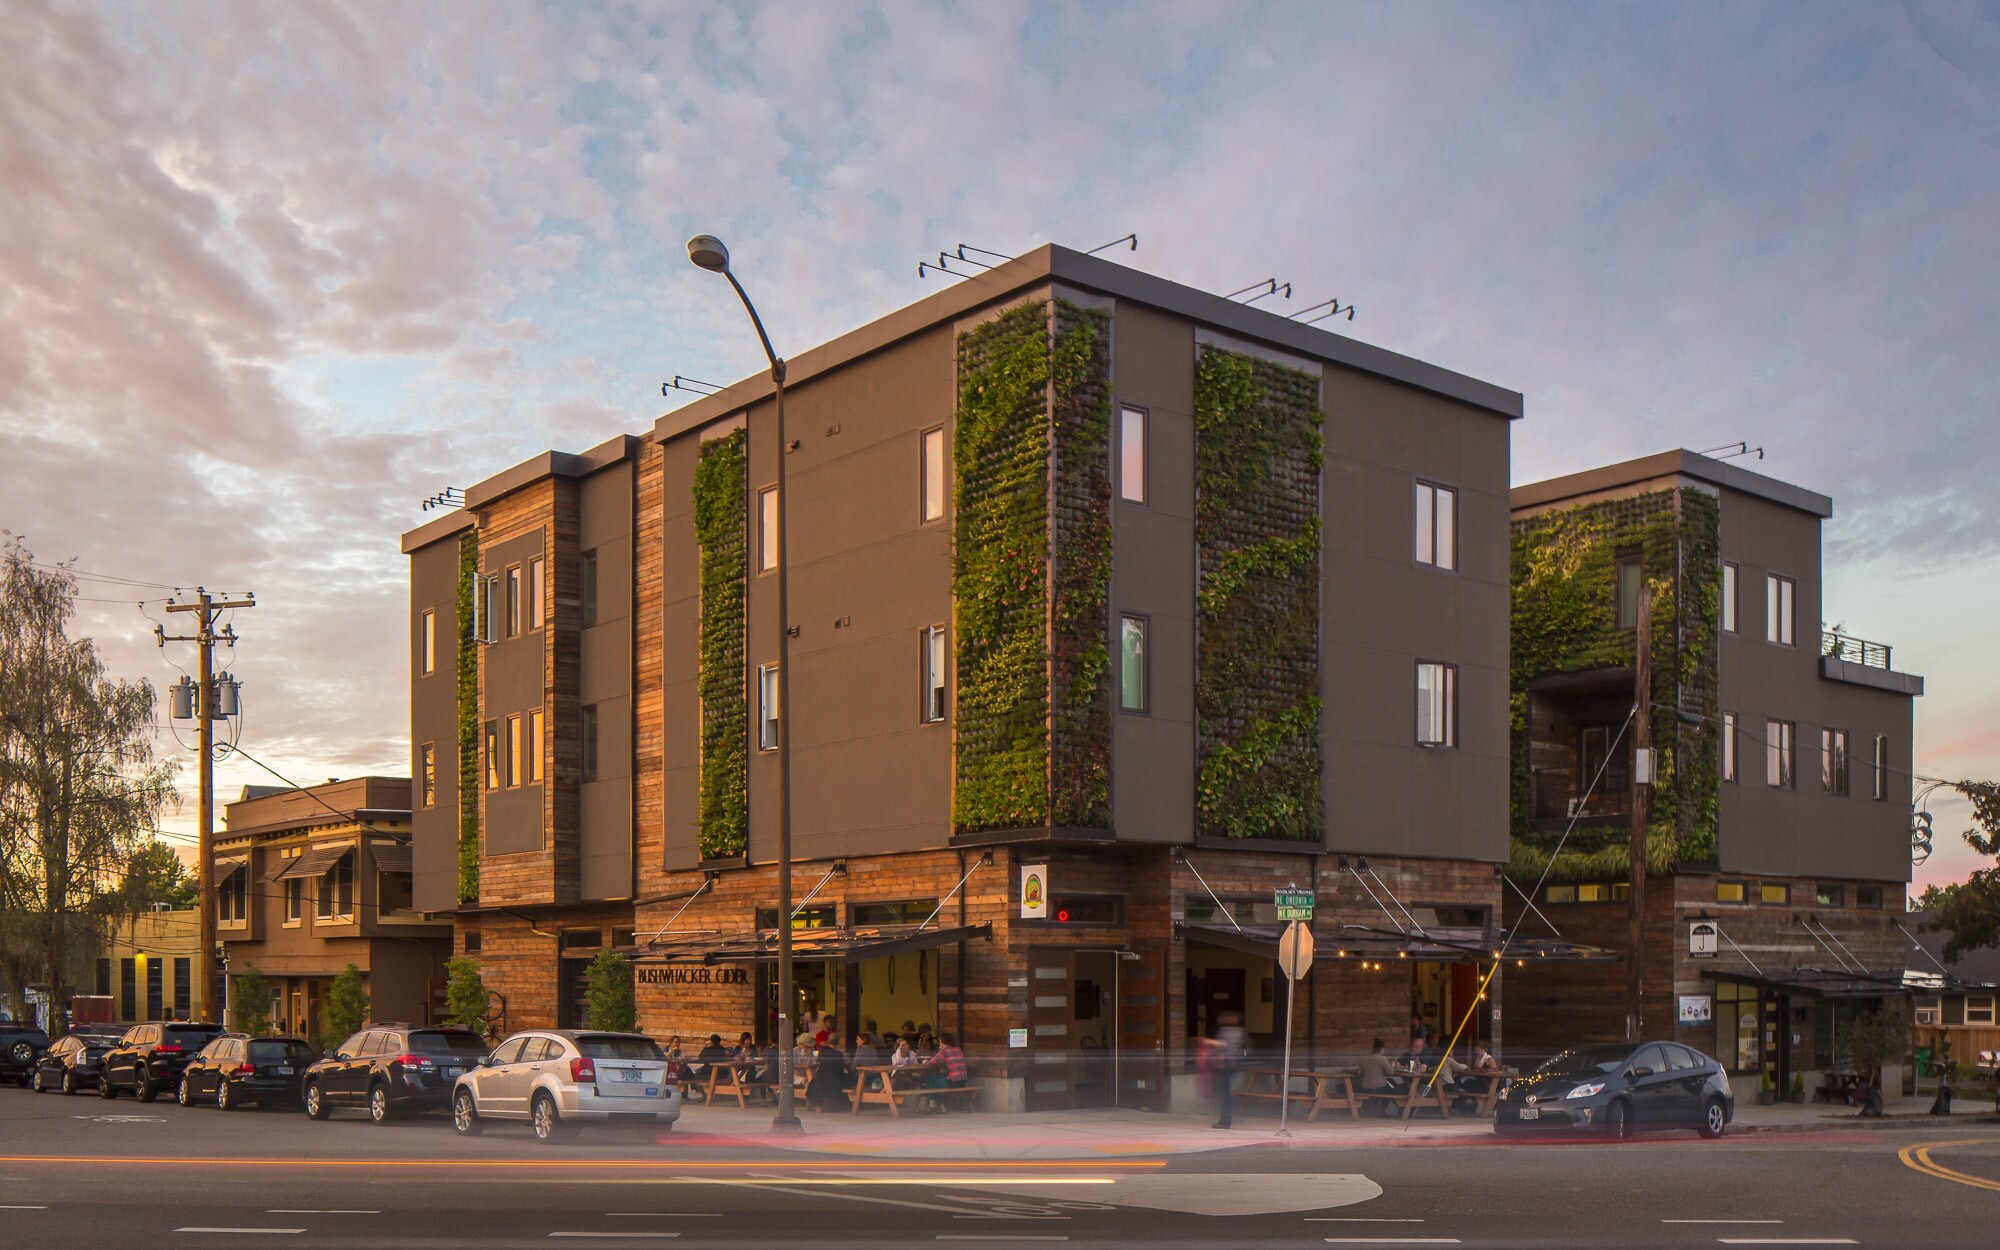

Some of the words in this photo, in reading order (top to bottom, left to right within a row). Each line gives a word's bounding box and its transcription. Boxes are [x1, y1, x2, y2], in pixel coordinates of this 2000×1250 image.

[1277, 896, 1283, 905] NE
[1286, 896, 1307, 905] ONEONTA
[1279, 908, 1286, 918] NE
[639, 969, 711, 983] BUSHWHACKER
[716, 969, 748, 983] CIDER
